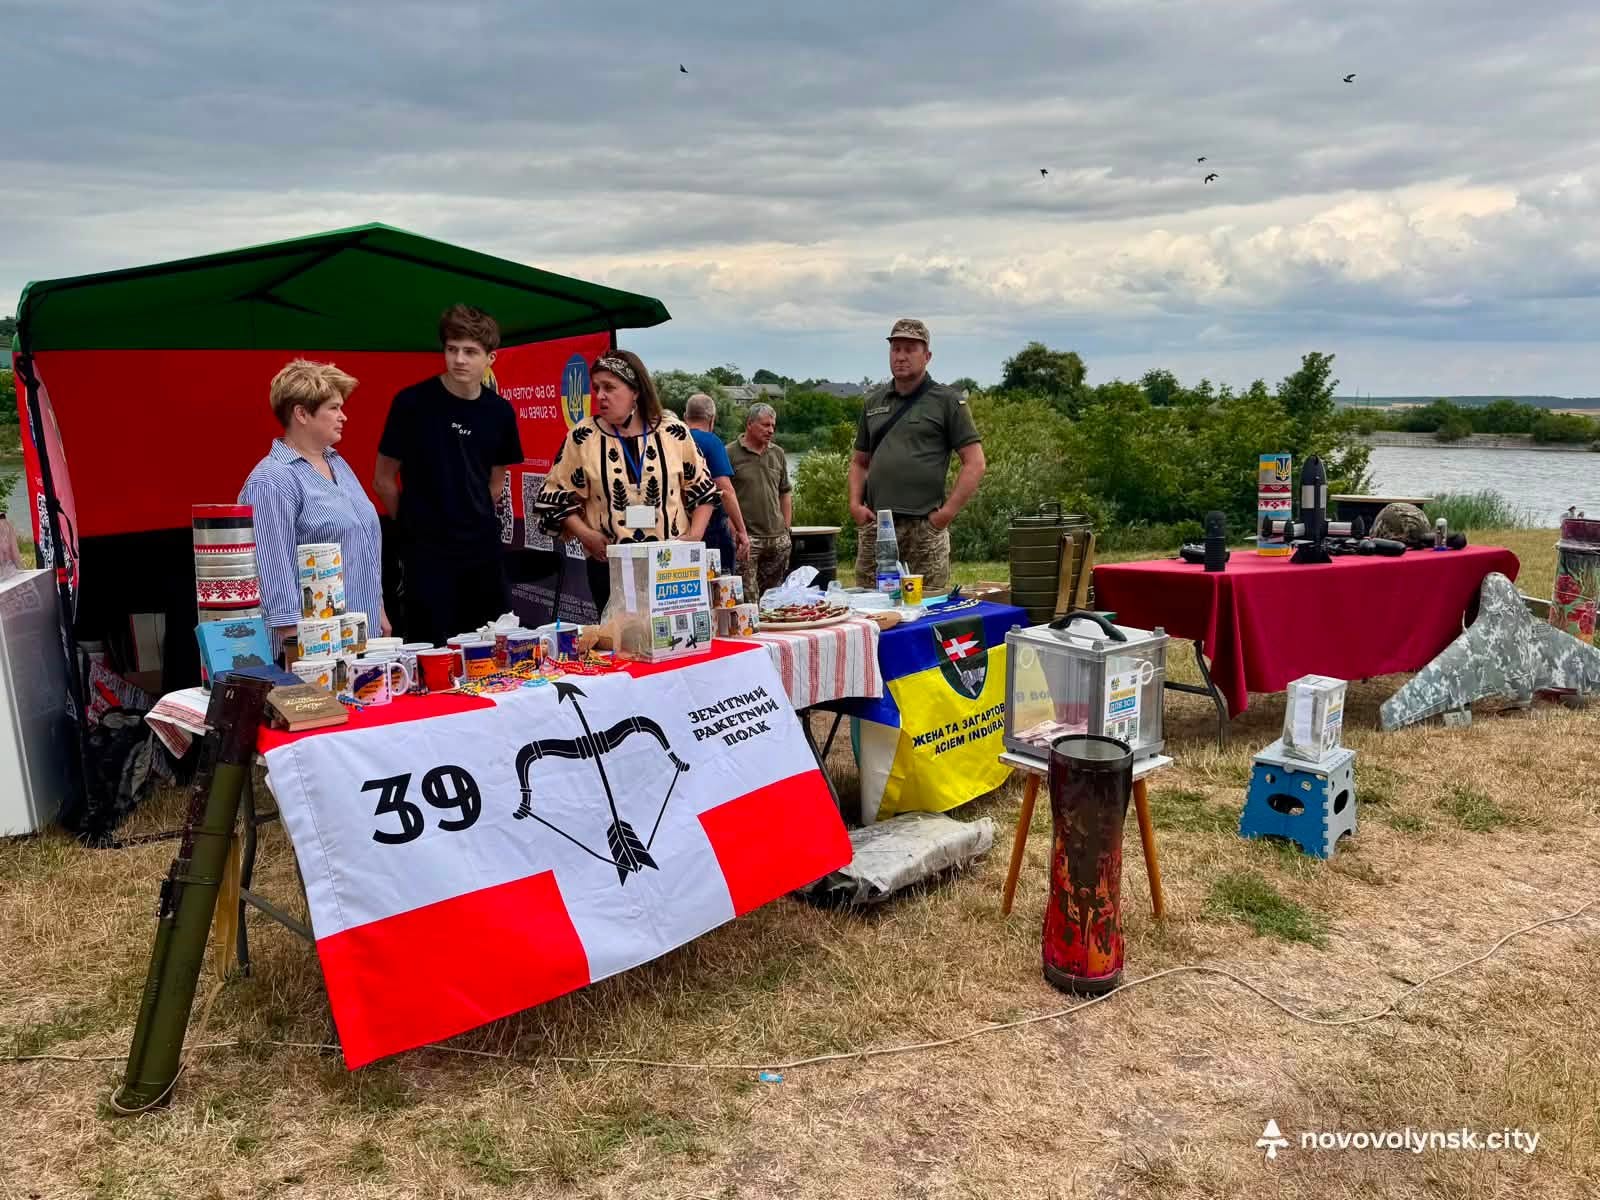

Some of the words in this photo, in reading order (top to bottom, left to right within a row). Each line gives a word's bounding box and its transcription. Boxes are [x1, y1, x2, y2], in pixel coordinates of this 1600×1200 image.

[657, 584, 679, 599] ДЛЯ
[680, 582, 699, 595] ЗСУ
[688, 685, 768, 724] ЗЕНІТНИЙ
[692, 698, 780, 742] РАКЕТНИЙ
[722, 720, 771, 746] ПОЛК
[945, 722, 959, 735] ТА
[935, 734, 966, 756] ACIEM
[360, 765, 482, 844] 39
